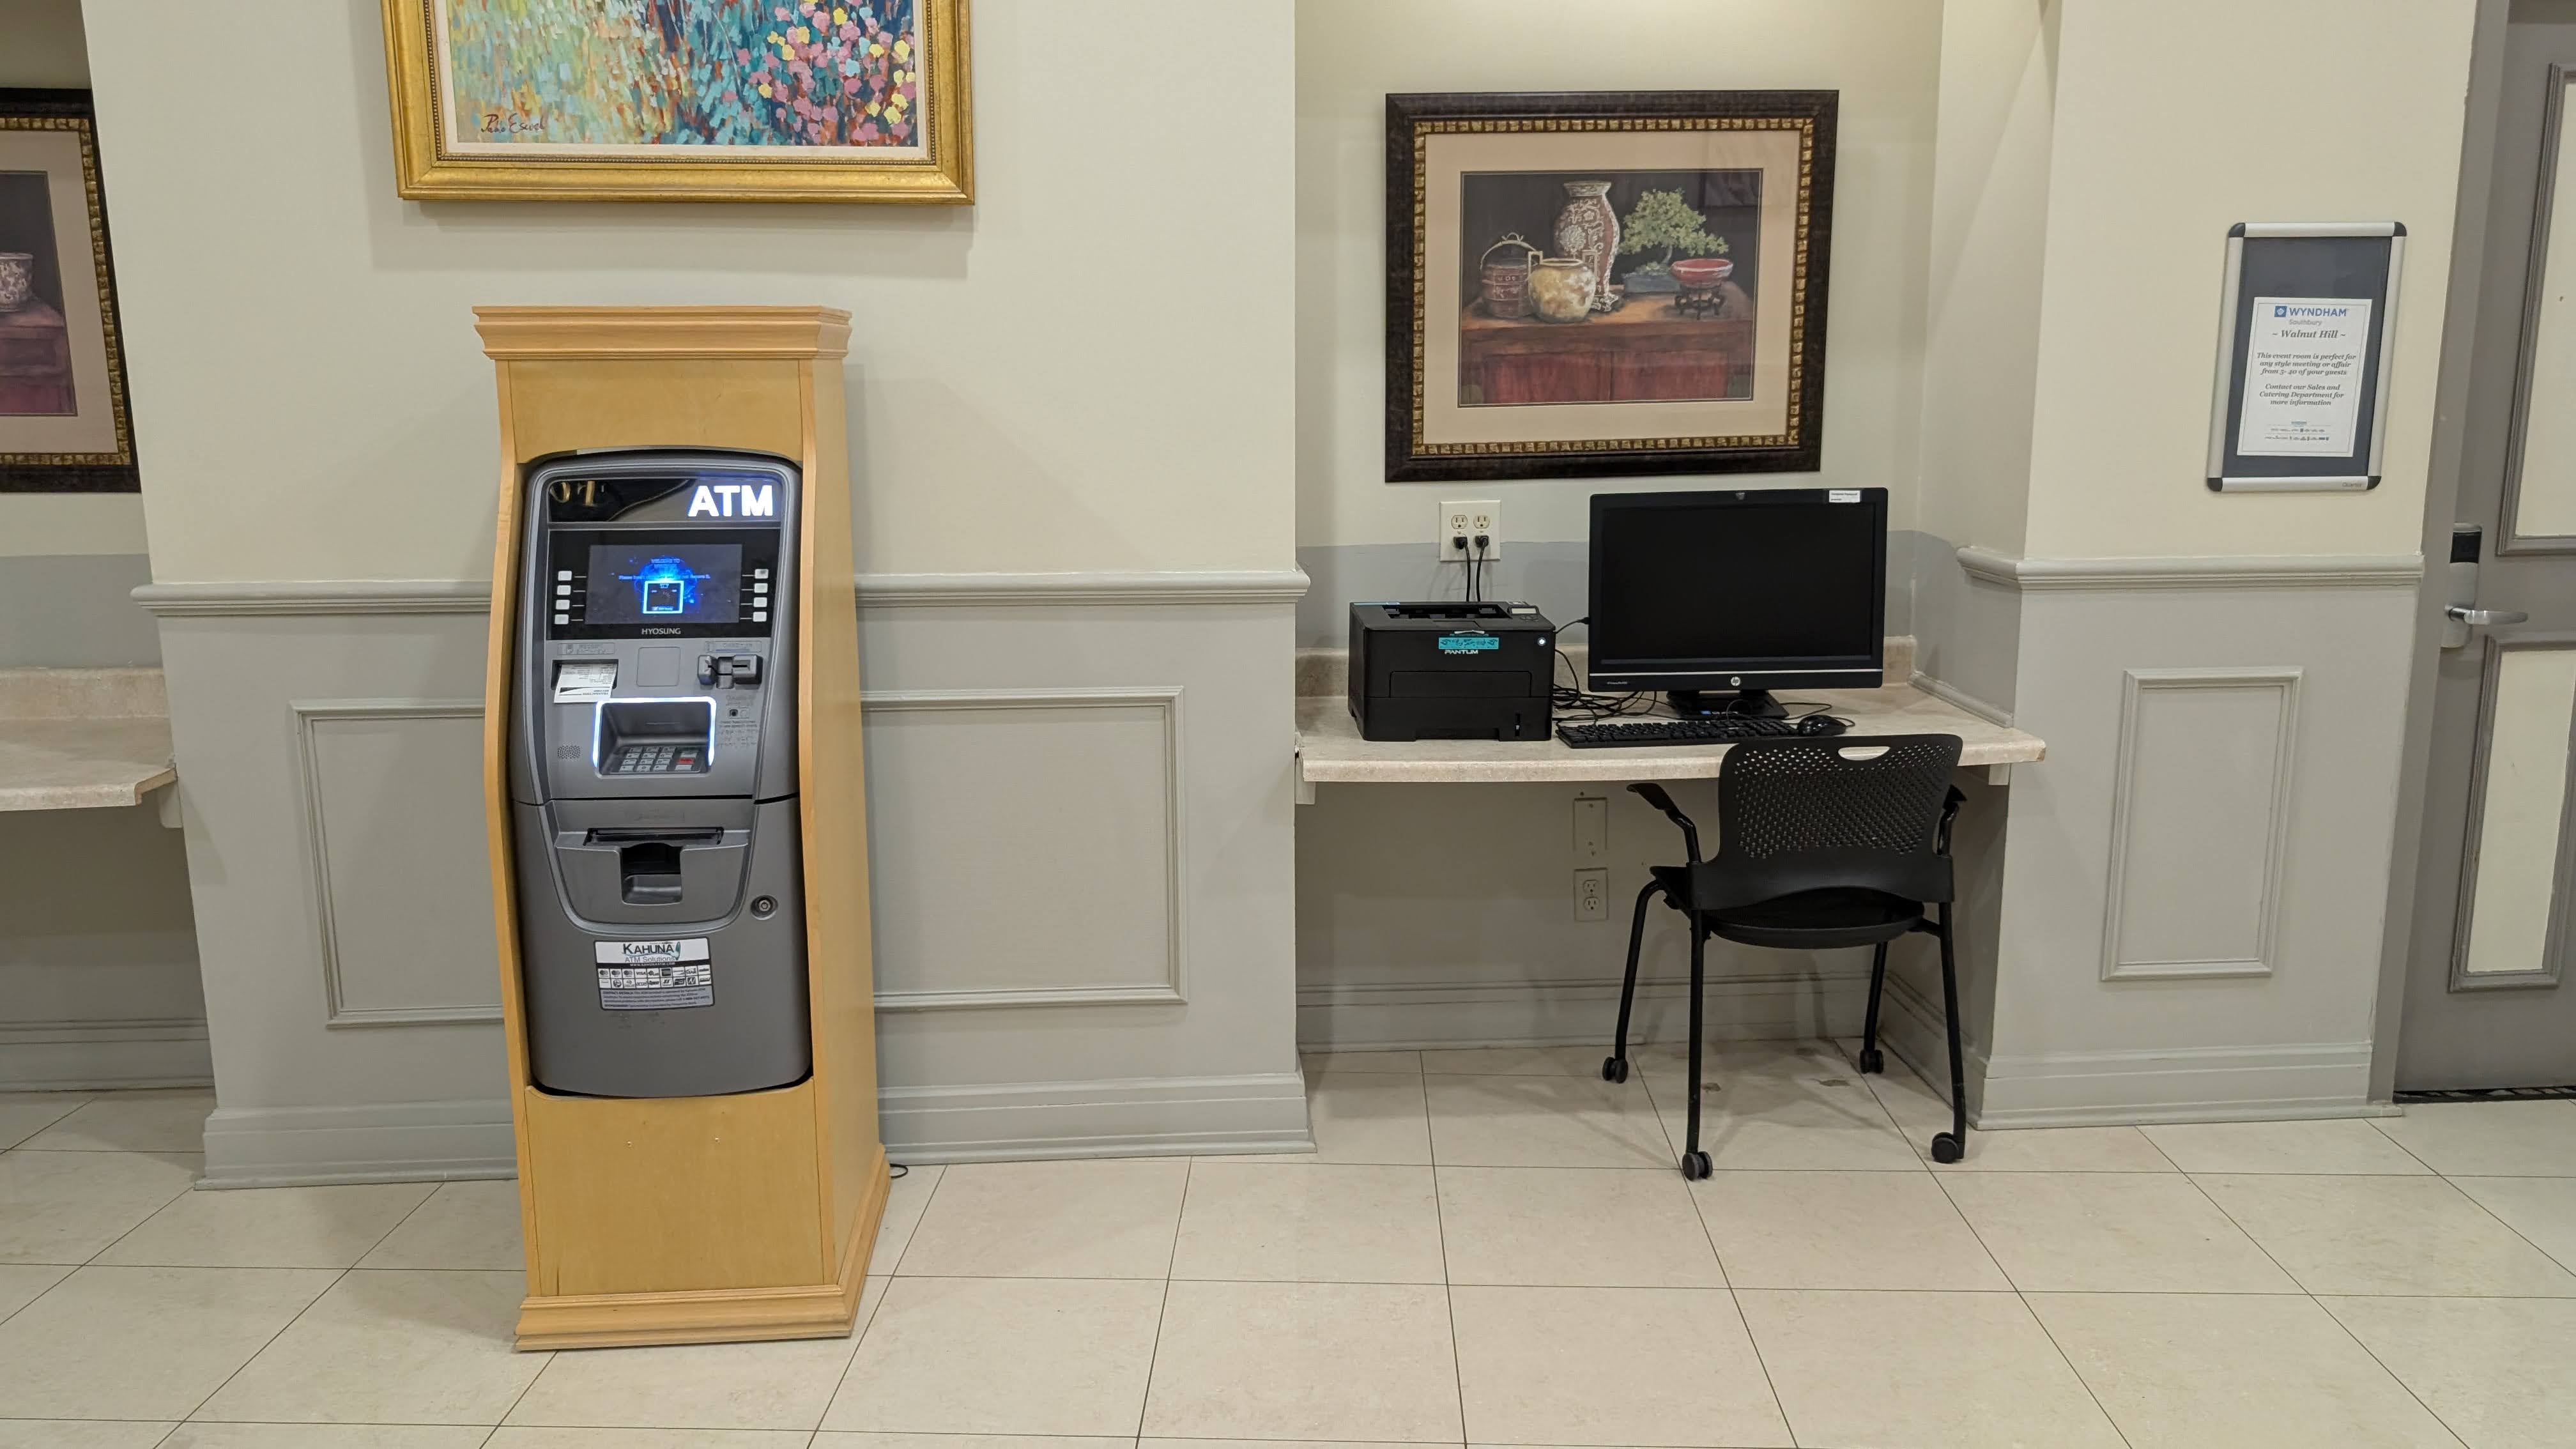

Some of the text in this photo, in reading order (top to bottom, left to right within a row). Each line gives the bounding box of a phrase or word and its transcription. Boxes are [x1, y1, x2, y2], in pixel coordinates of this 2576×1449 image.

[2289, 307, 2347, 317] WYNDHAM
[2281, 330, 2317, 338] Walnut
[2319, 330, 2338, 339] Hill
[687, 485, 774, 517] ATM
[1731, 676, 1740, 686] hp
[623, 943, 675, 954] KAHUNA
